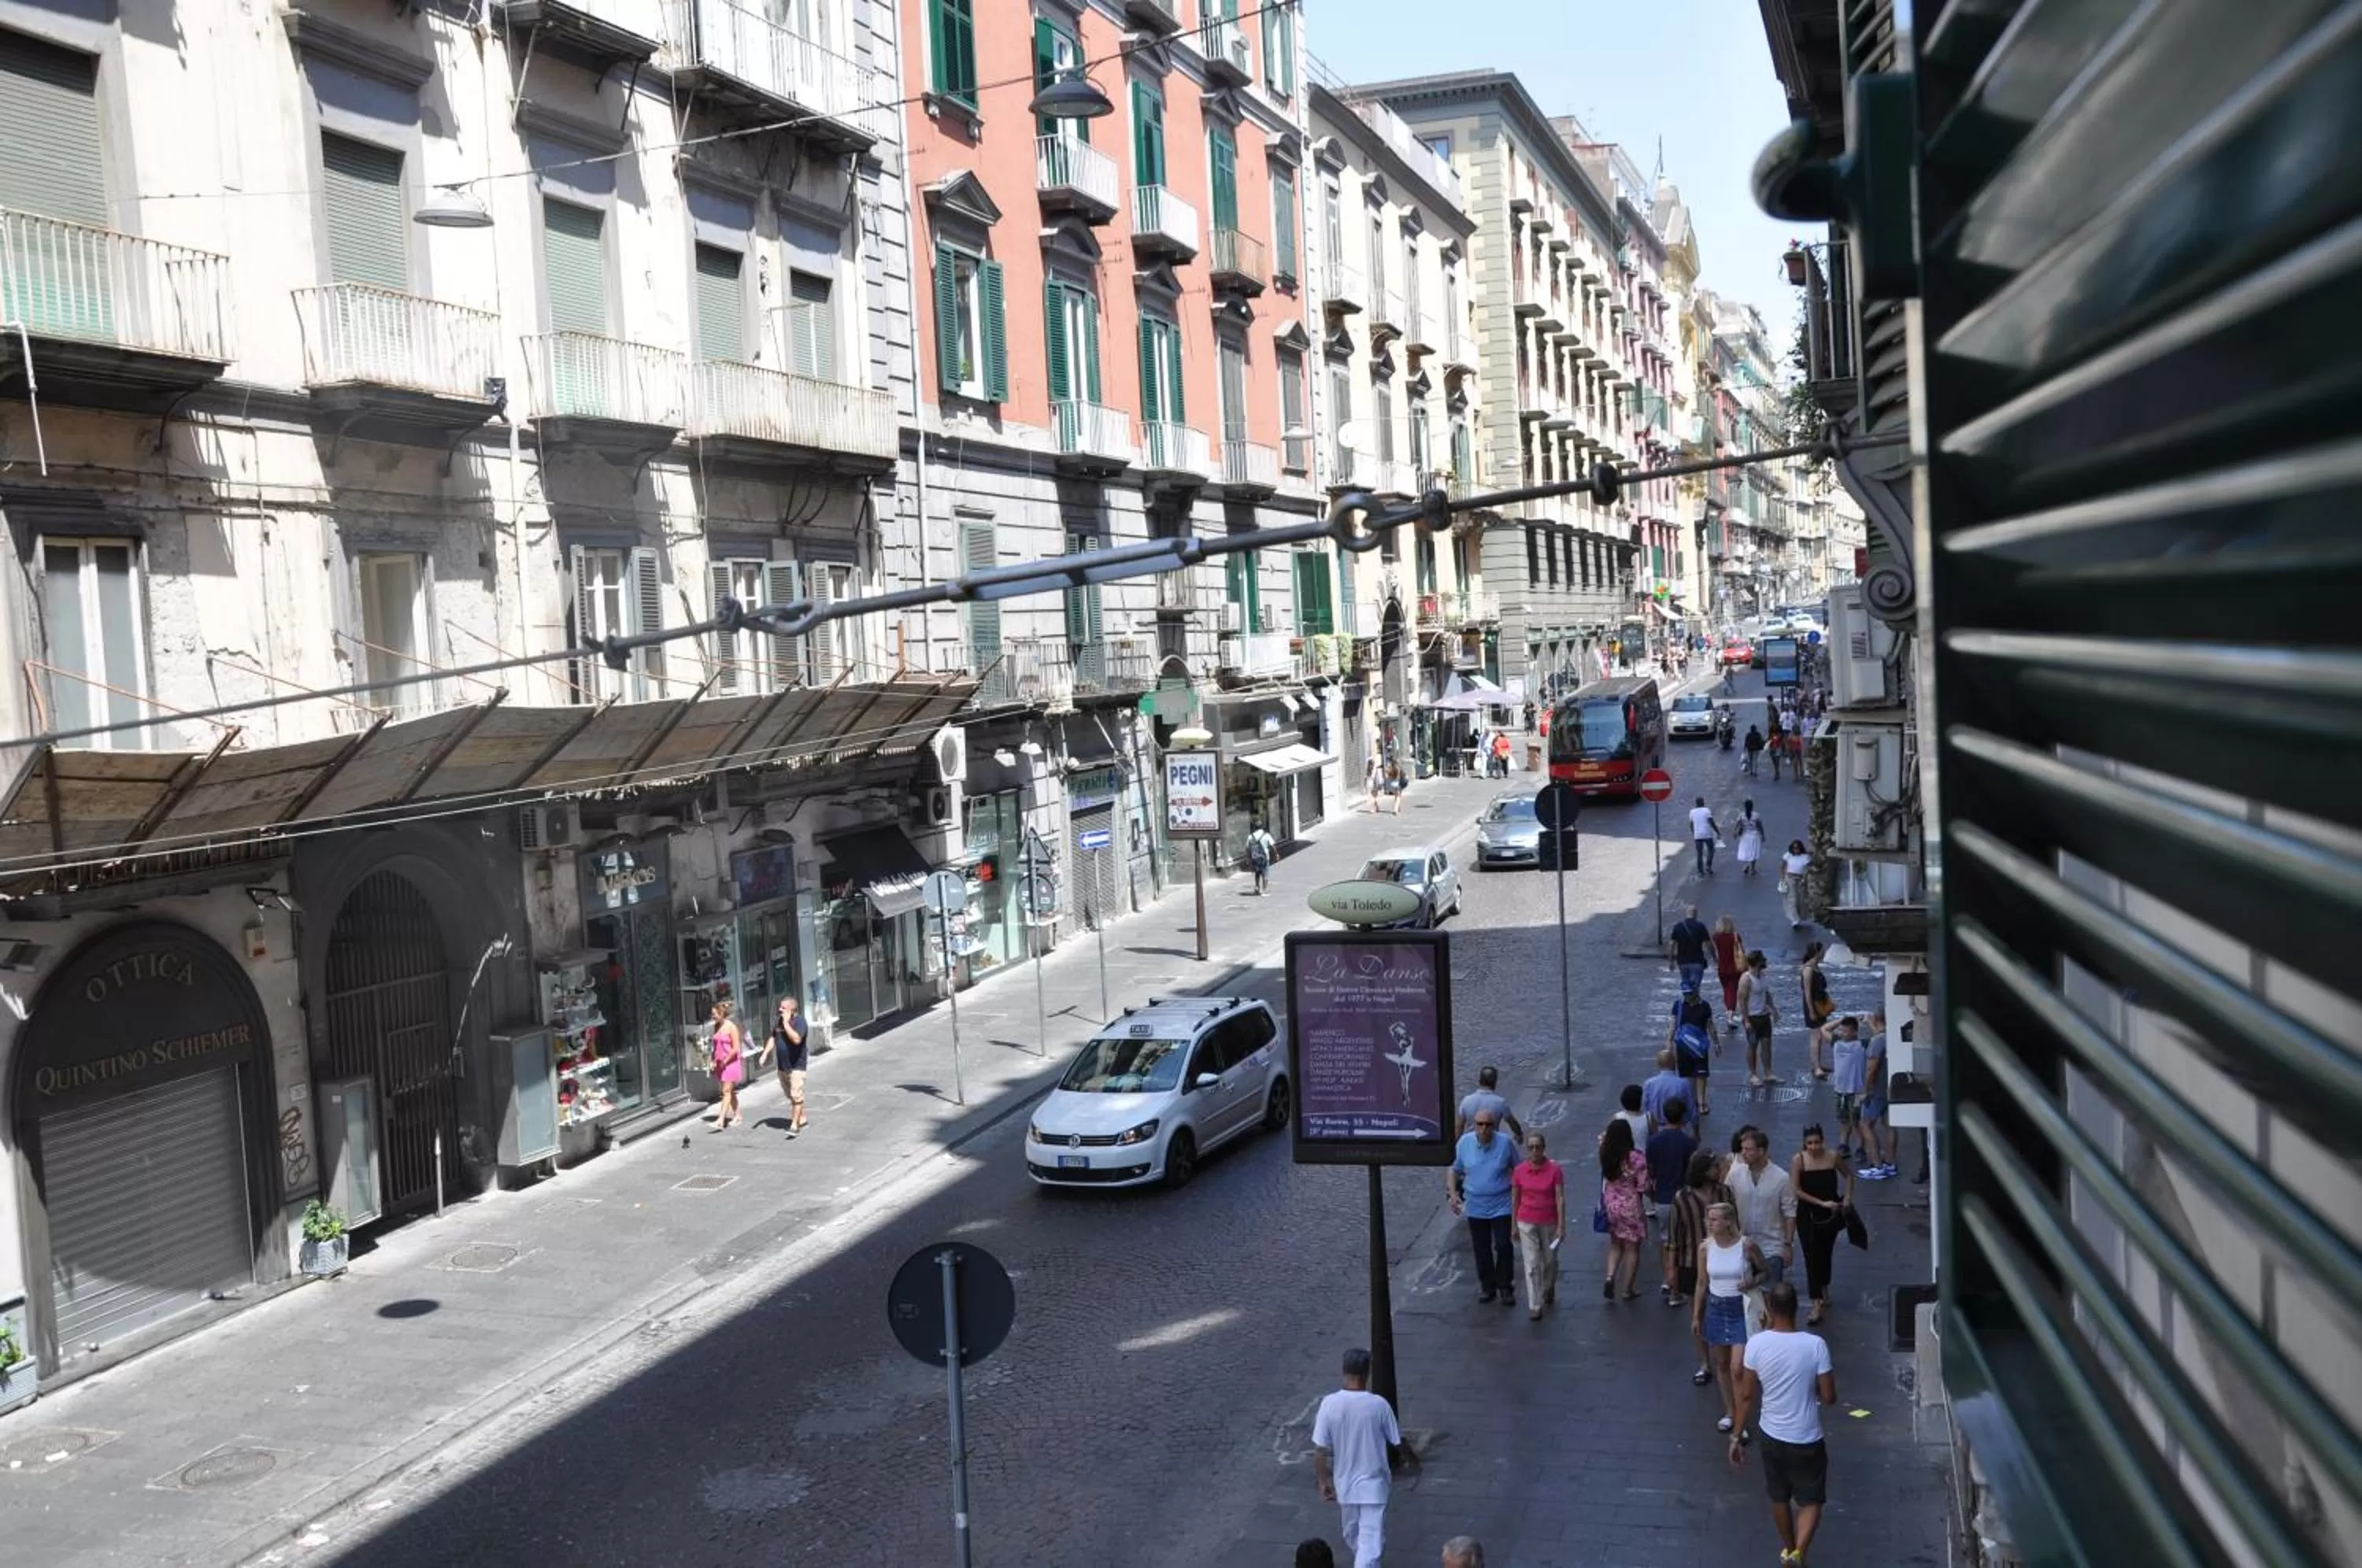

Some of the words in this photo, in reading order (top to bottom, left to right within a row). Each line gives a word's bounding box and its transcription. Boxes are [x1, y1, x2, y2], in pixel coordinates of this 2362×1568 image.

[1170, 765, 1212, 785] PEGNI
[1331, 900, 1347, 910] via
[1351, 898, 1392, 910] Toledo
[86, 952, 194, 1003] OTTICA
[1304, 952, 1347, 983] La
[35, 1049, 148, 1096] QUINTINO
